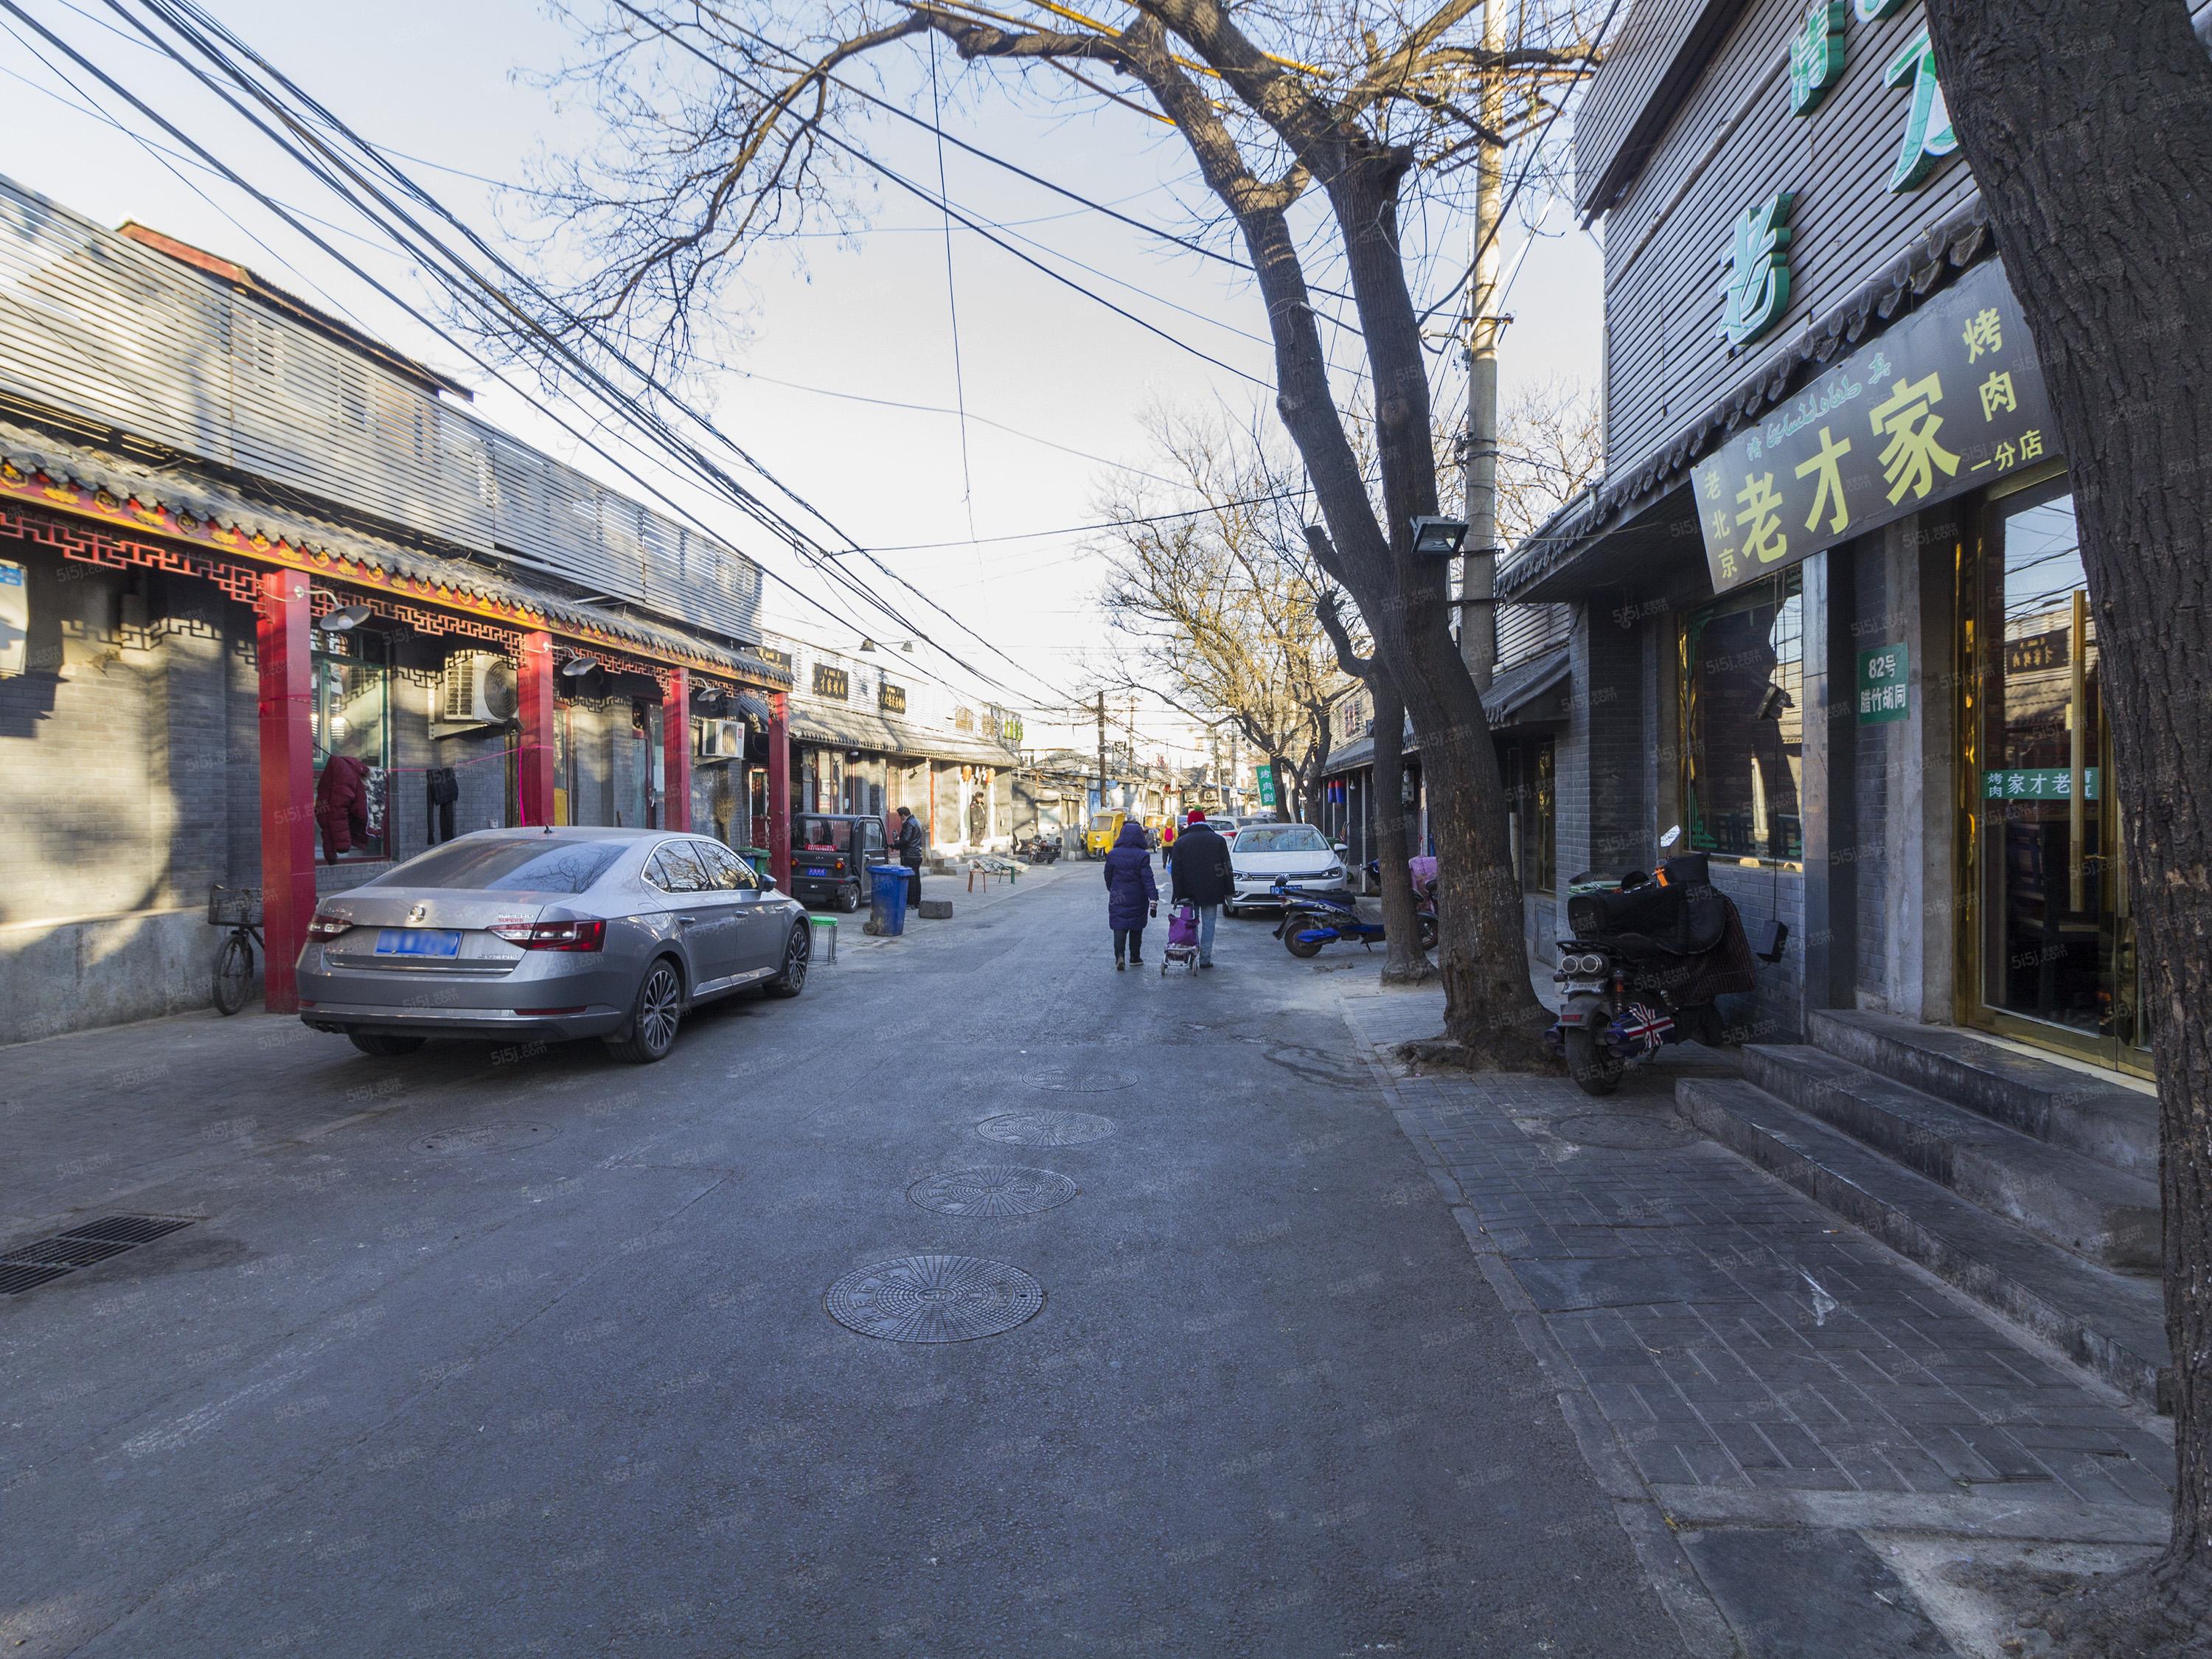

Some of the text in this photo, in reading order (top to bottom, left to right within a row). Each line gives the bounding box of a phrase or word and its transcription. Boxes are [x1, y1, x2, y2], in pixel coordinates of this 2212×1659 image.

[1962, 307, 2018, 422] 烤肉
[1734, 372, 1961, 564] 老才家
[1970, 429, 2044, 472] 一分店
[1704, 470, 1738, 579] 老北京
[1868, 654, 1896, 678] 82号
[1860, 684, 1906, 714] 腊竹胡同
[1987, 773, 2003, 797] 烤肉
